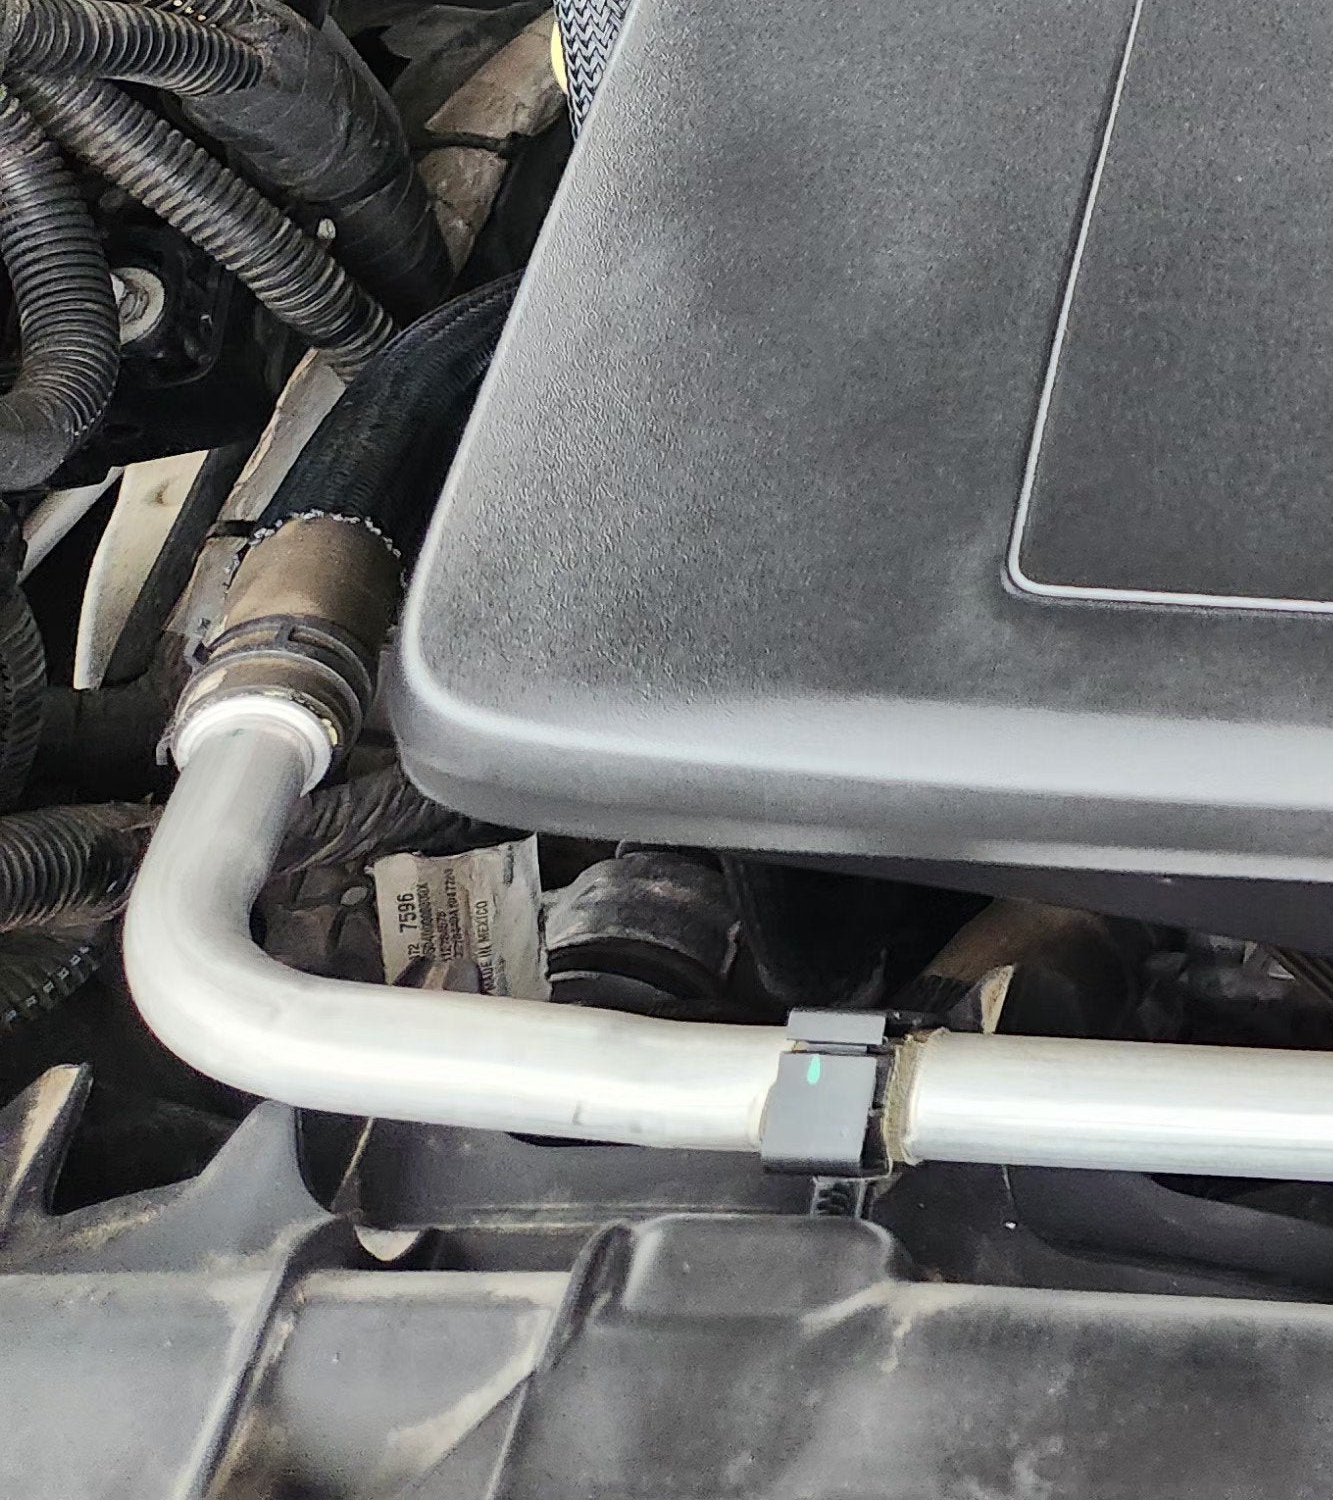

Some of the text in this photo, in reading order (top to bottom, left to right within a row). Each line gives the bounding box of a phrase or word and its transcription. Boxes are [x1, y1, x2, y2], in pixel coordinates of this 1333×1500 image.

[397, 893, 417, 933] 7596
[475, 901, 497, 992] MADE IN MEXICO
